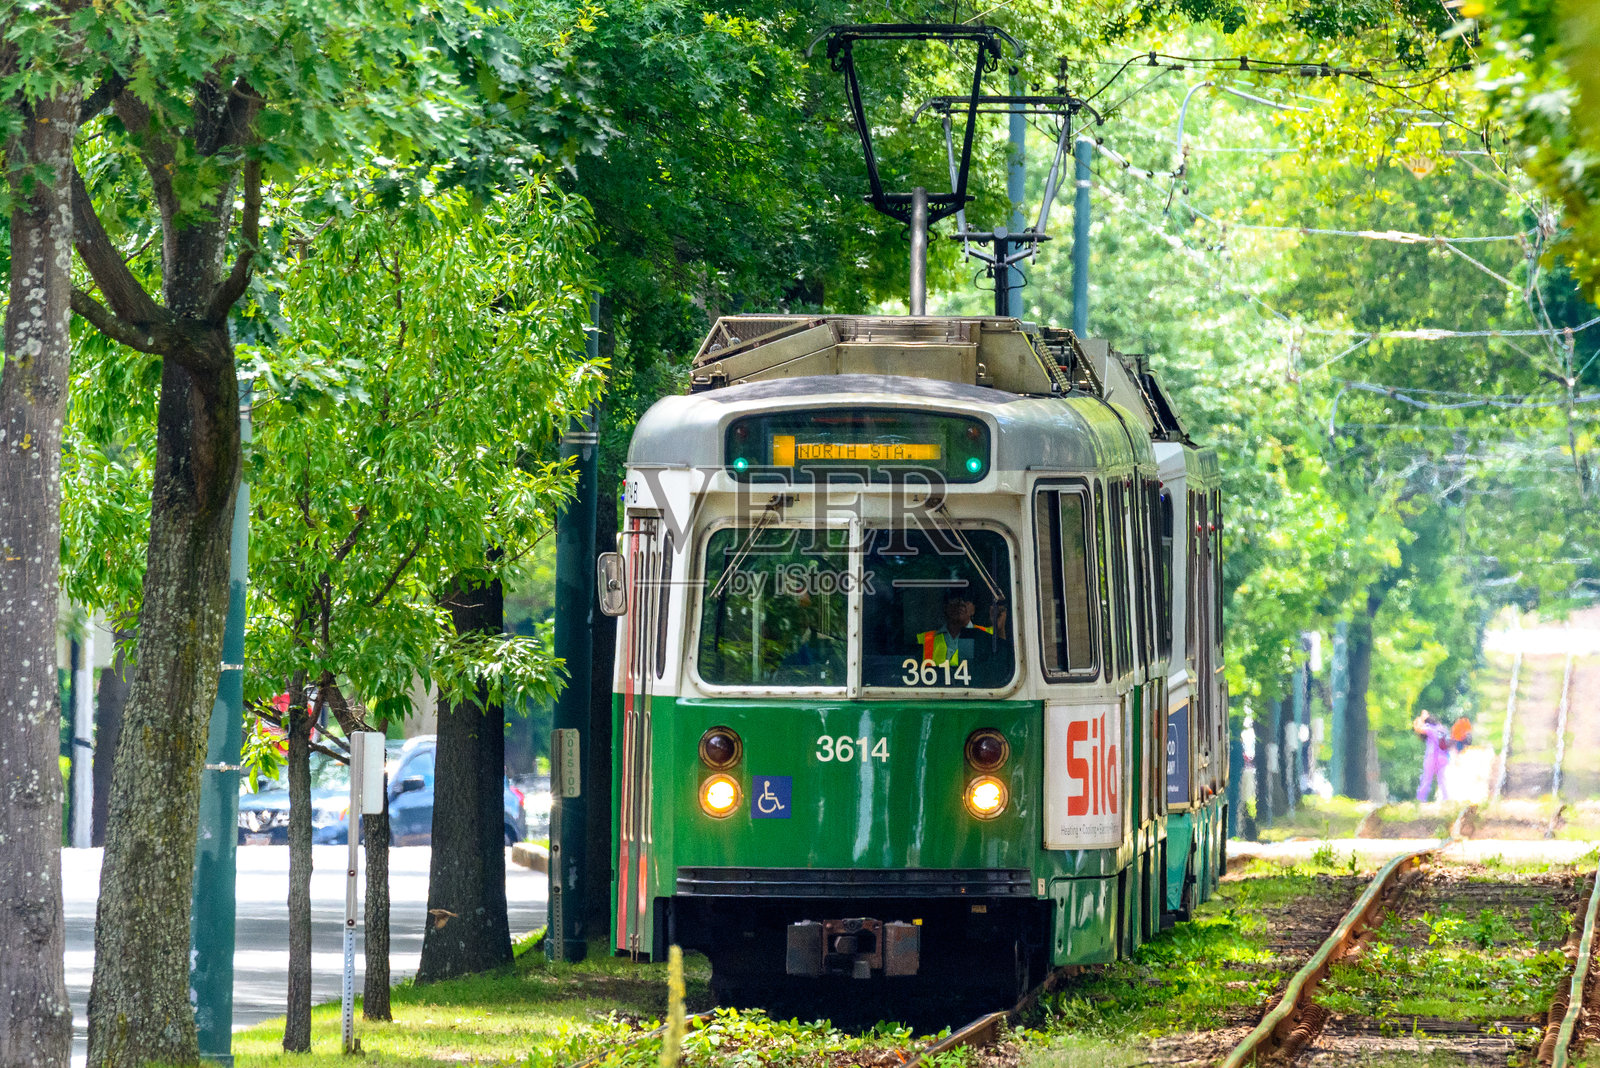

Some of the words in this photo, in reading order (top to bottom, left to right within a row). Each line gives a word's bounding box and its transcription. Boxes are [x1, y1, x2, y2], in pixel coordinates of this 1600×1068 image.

[799, 444, 856, 459] NORTH
[870, 444, 912, 459] STA.
[902, 658, 972, 686] 3614
[815, 735, 890, 763] 3614
